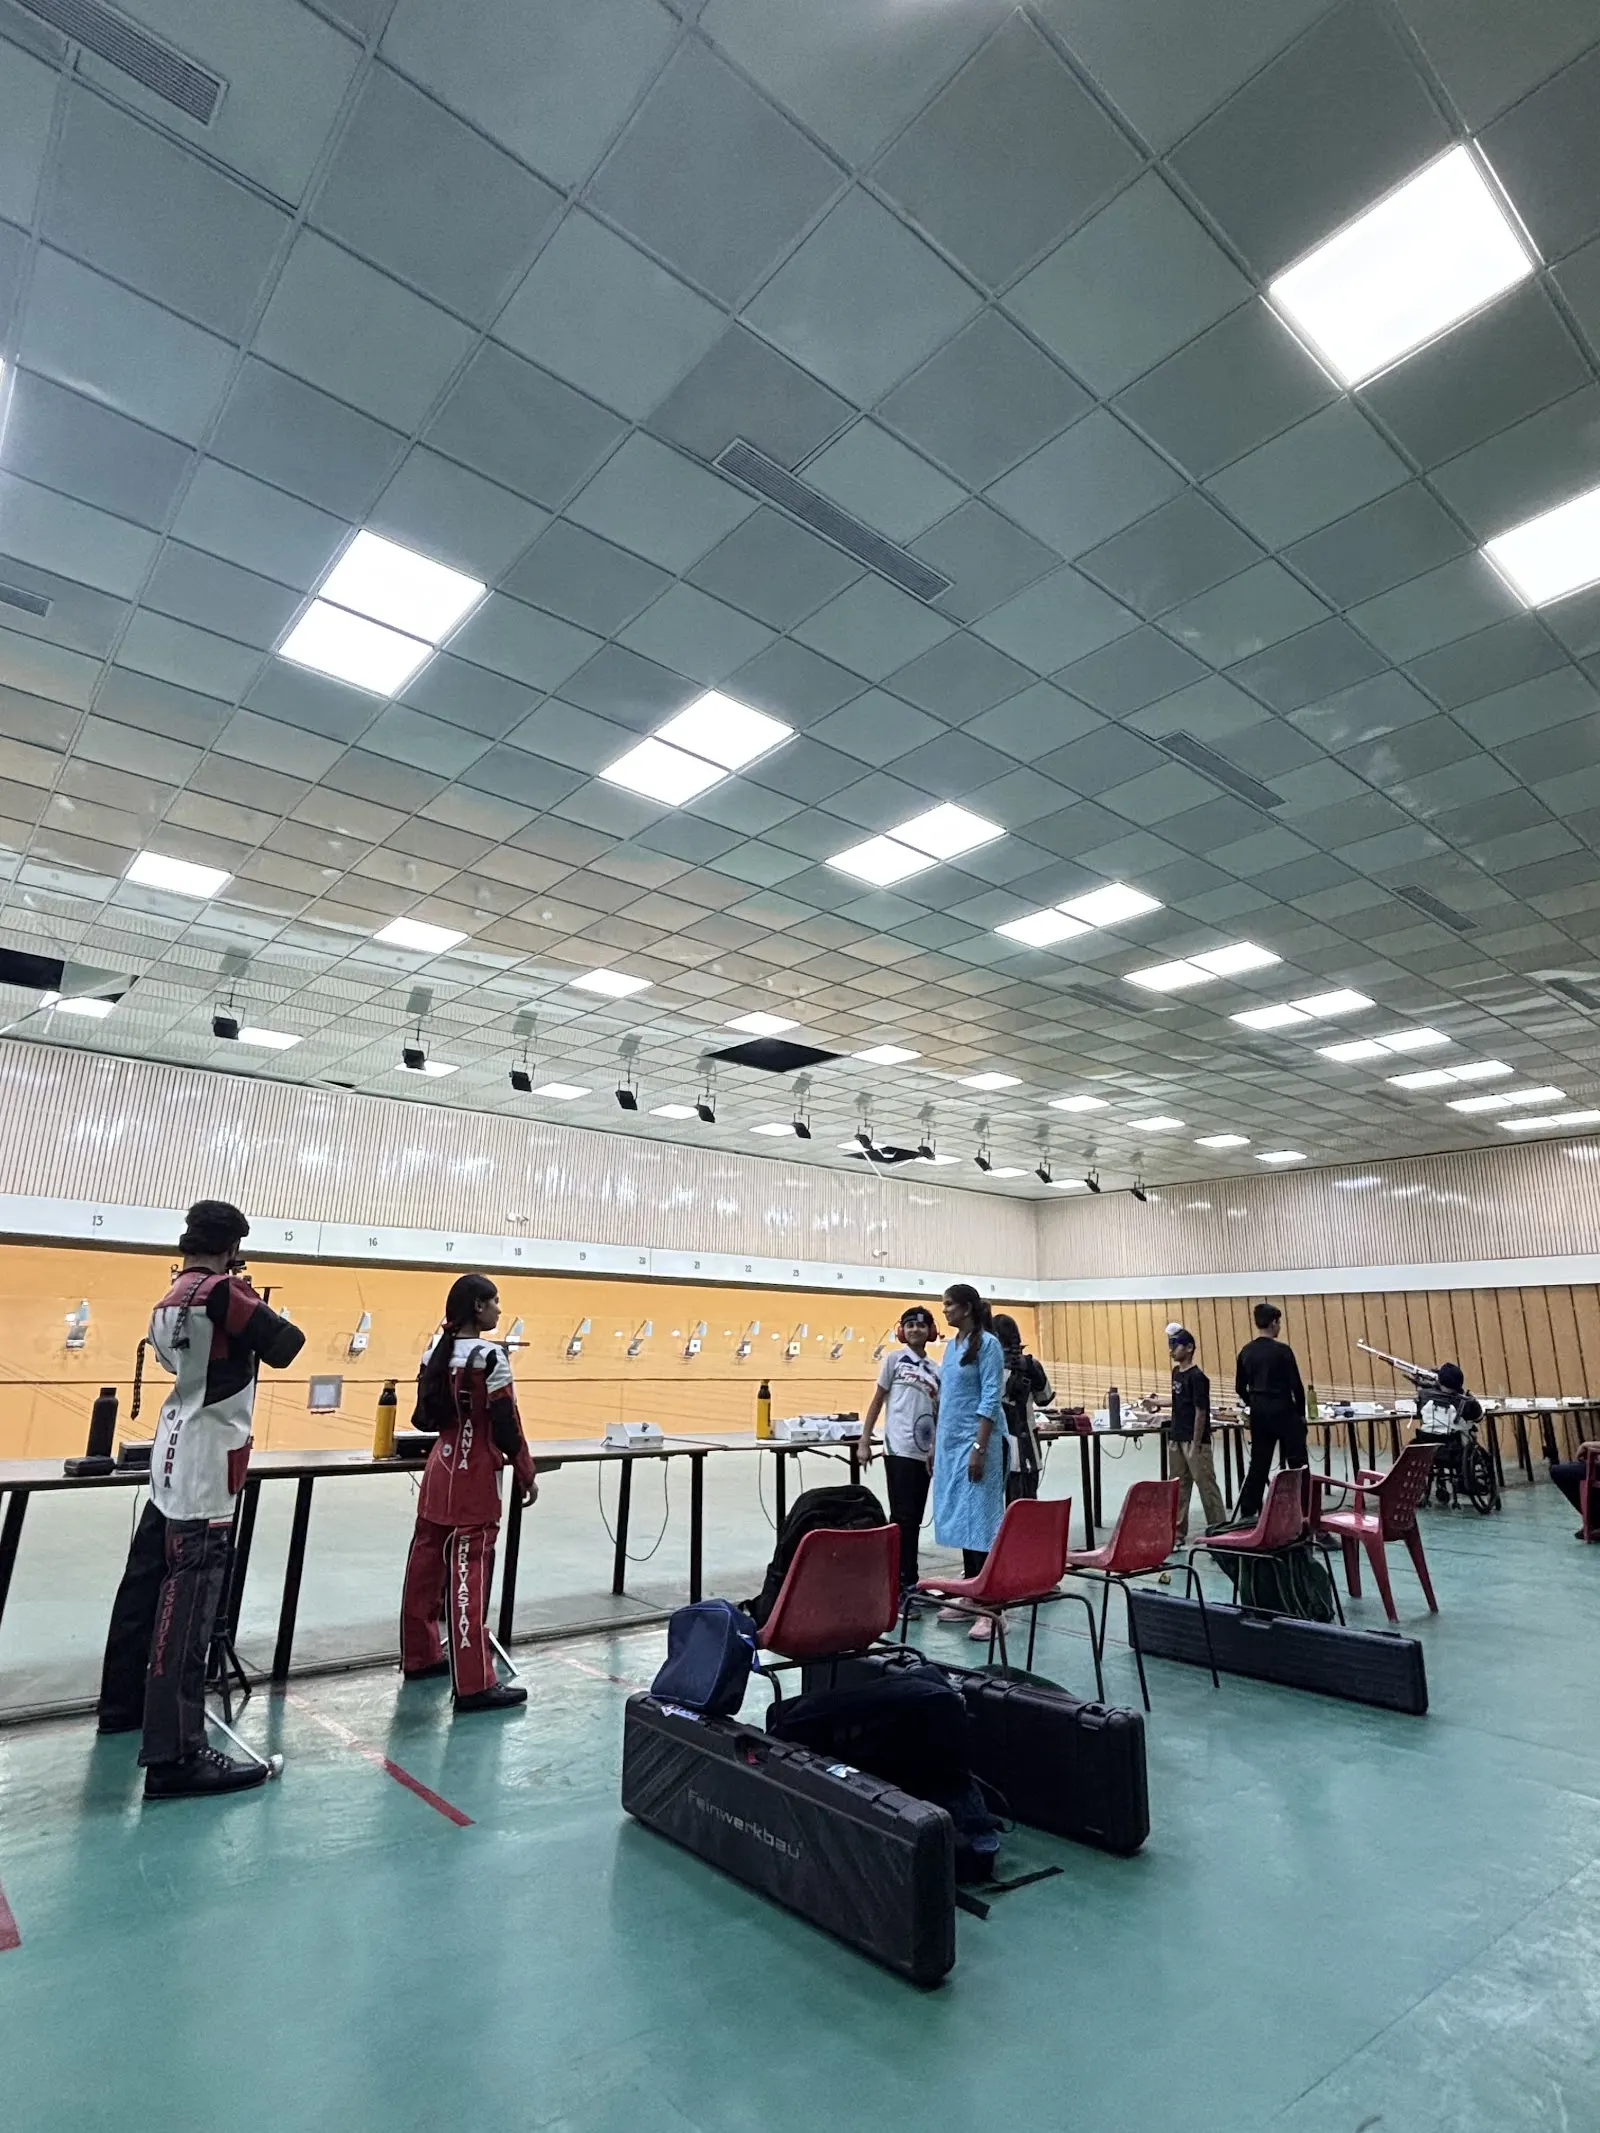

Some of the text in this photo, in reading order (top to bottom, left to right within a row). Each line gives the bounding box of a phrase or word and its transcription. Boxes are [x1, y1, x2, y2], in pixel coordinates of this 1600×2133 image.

[92, 1214, 104, 1227] 13
[284, 1230, 294, 1242] 15
[368, 1237, 378, 1247] 16
[445, 1241, 455, 1252] 17
[514, 1247, 522, 1257] 18
[579, 1251, 587, 1261] 19
[638, 1256, 647, 1265] 20
[744, 1264, 753, 1273] 22
[457, 1418, 474, 1470] ANNYA
[163, 1419, 184, 1489] RUDRA
[457, 1535, 472, 1649] SHRIVASTAVA
[687, 1788, 801, 1860] Feinwerkbau
